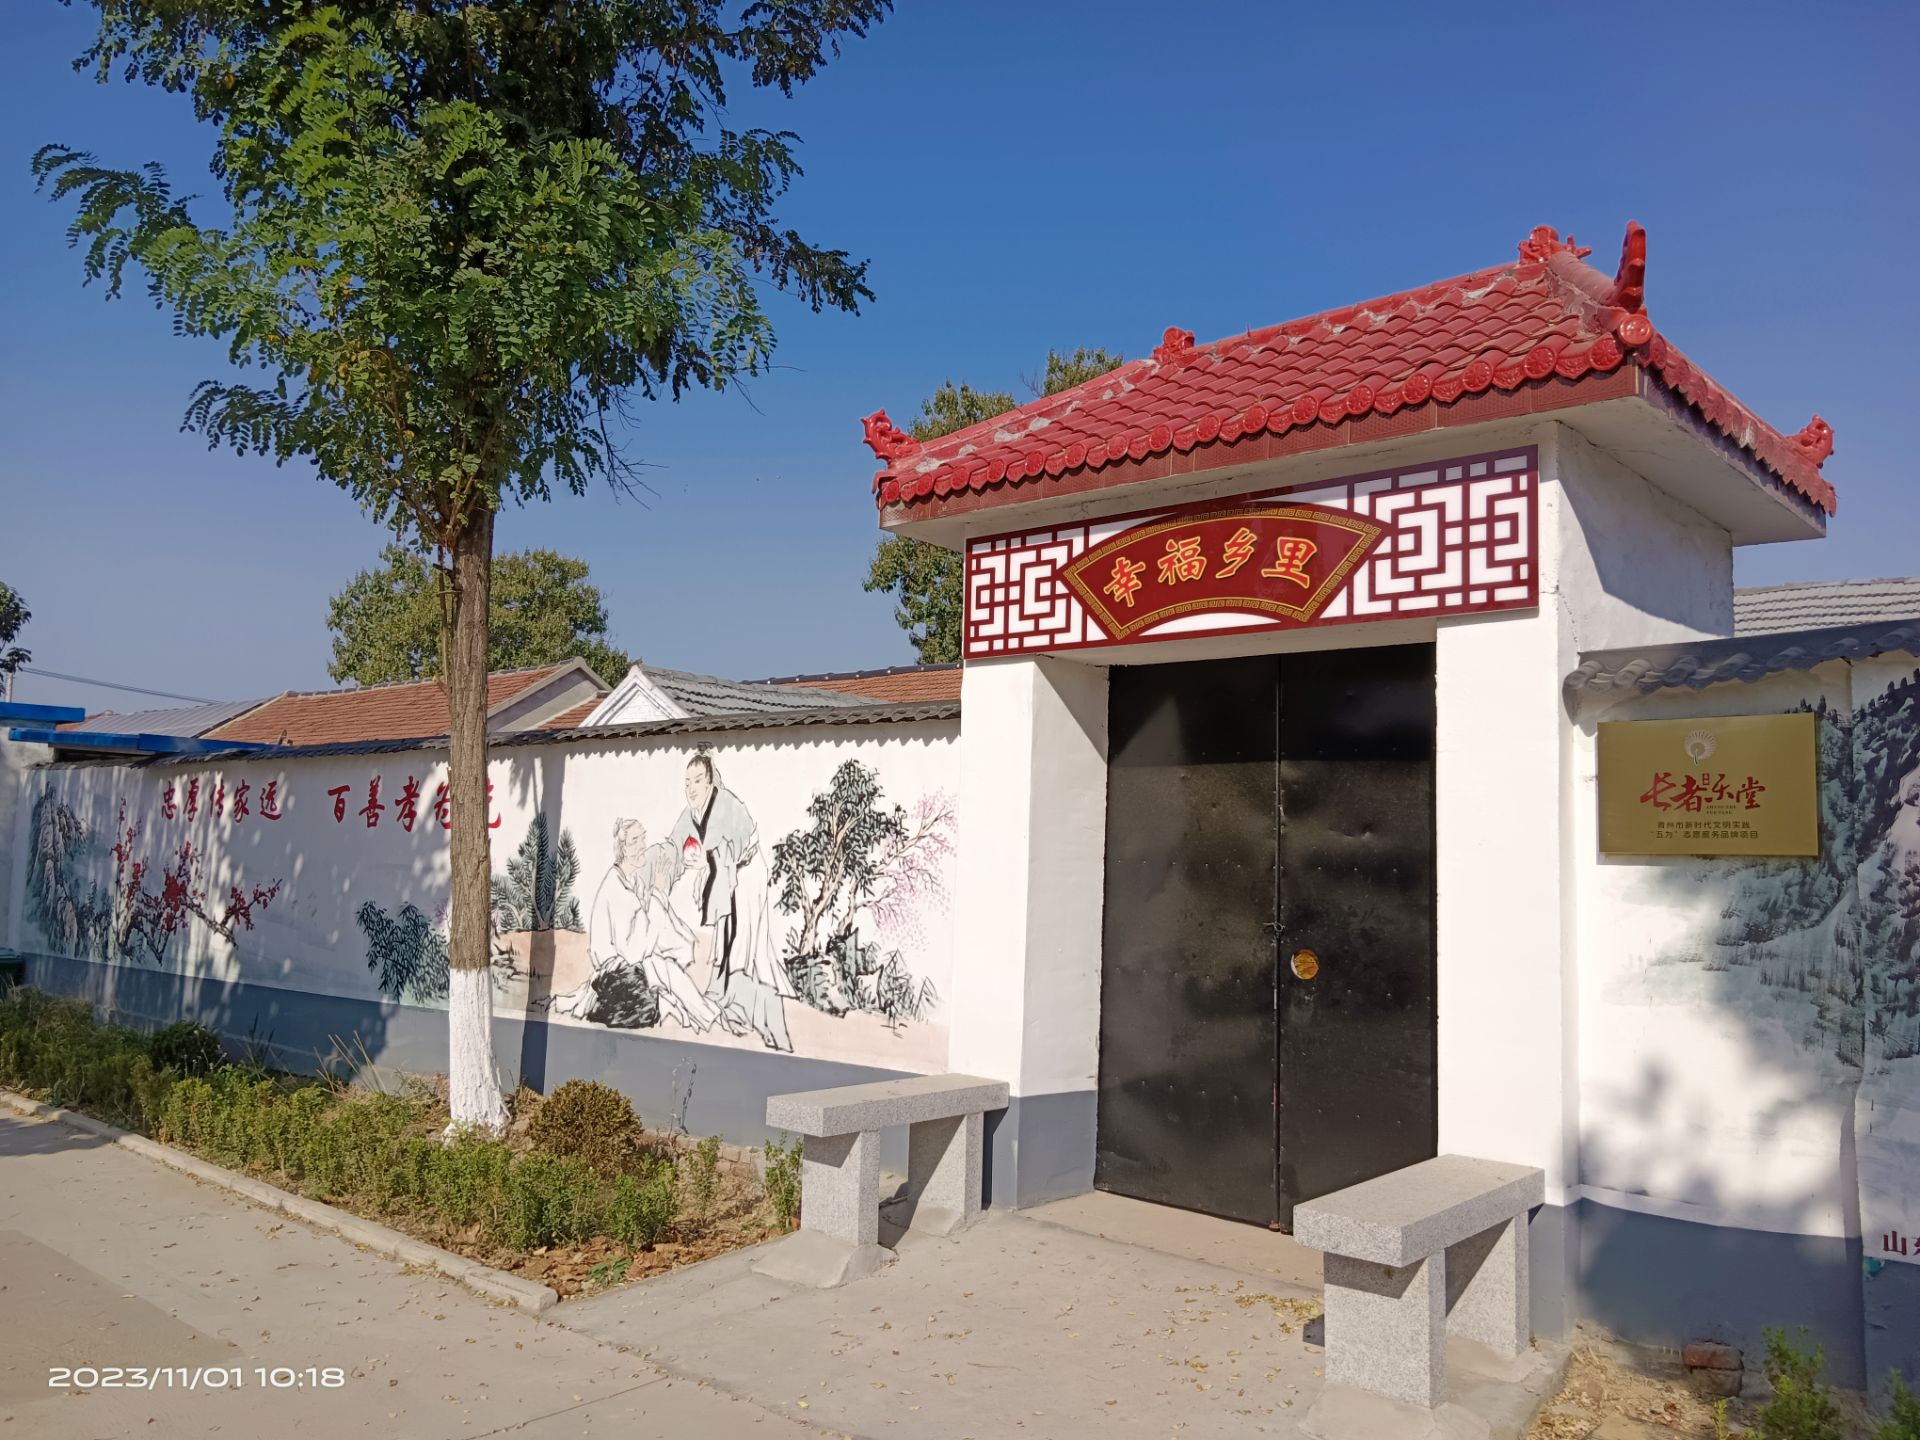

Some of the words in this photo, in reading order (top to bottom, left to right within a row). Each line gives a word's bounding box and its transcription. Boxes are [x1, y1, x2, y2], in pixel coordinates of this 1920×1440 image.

[1103, 527, 1318, 607] 幸福乡里
[1640, 772, 1766, 812] 长者乐堂
